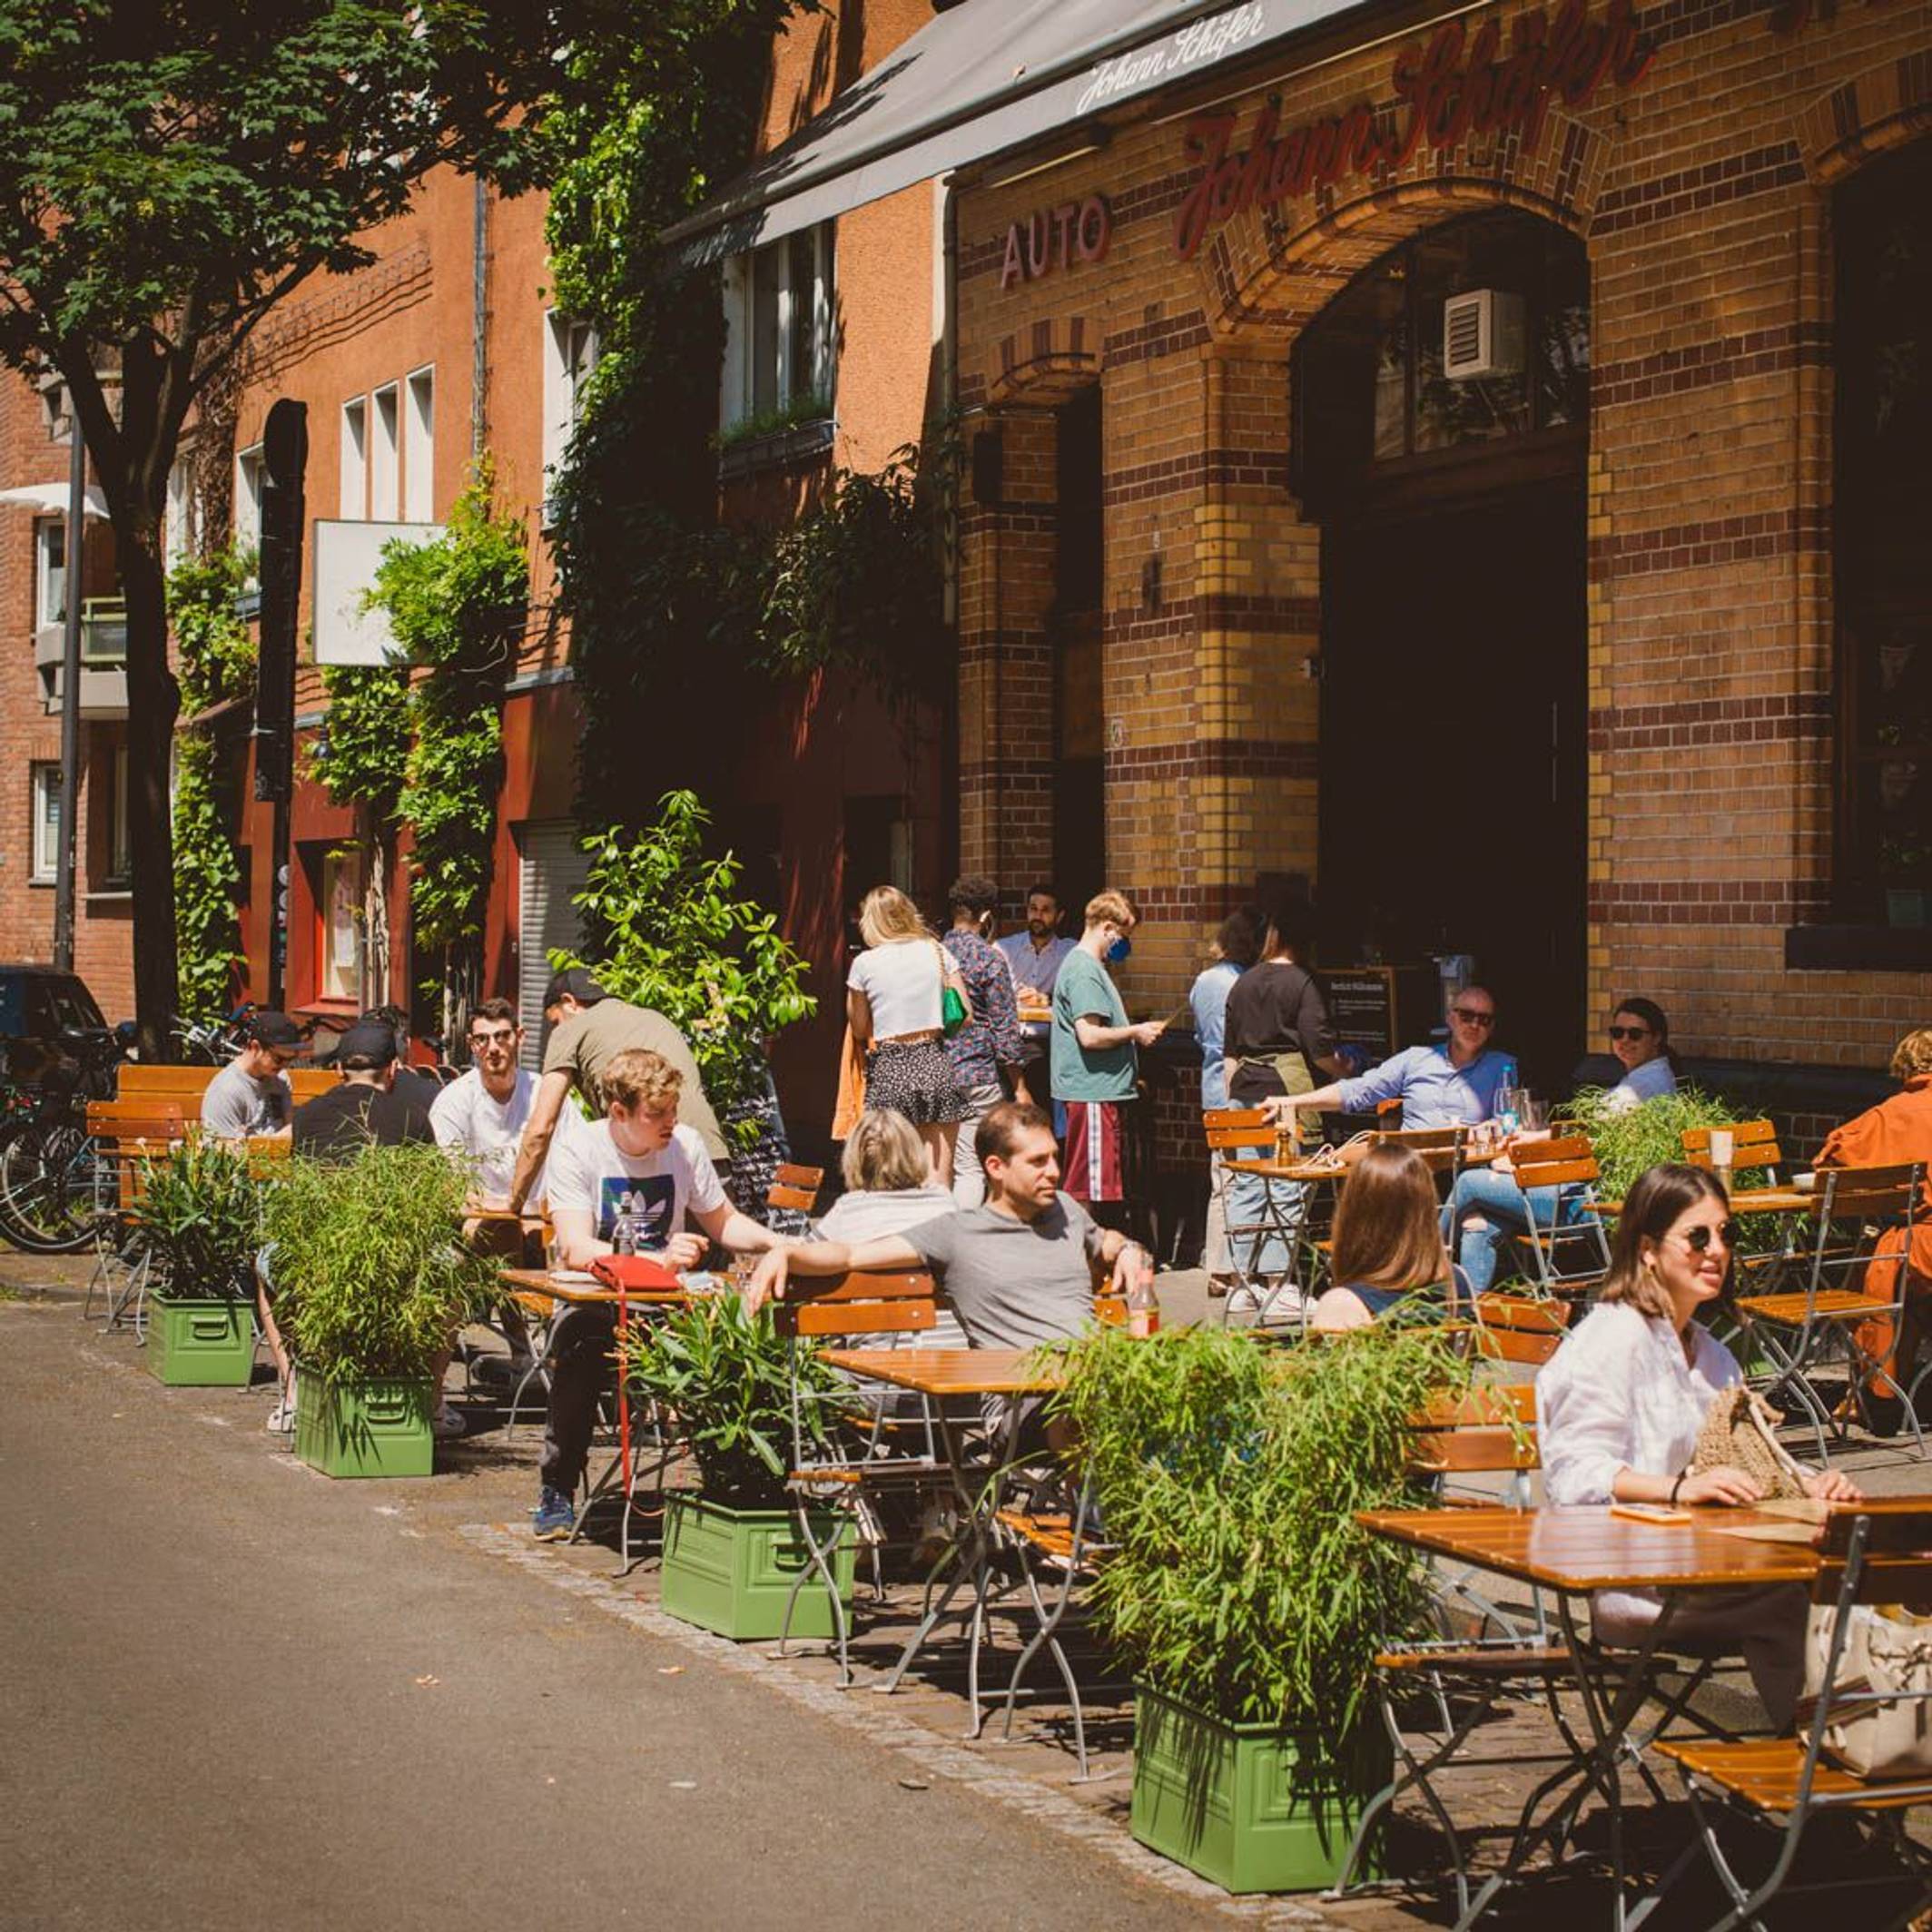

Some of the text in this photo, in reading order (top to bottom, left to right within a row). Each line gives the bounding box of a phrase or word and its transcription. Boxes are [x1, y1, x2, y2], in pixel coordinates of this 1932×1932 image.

[1075, 4, 1266, 115] Johann Schäfer
[1173, 0, 1656, 260] Johann Schäfer
[1000, 196, 1109, 289] AUTO
